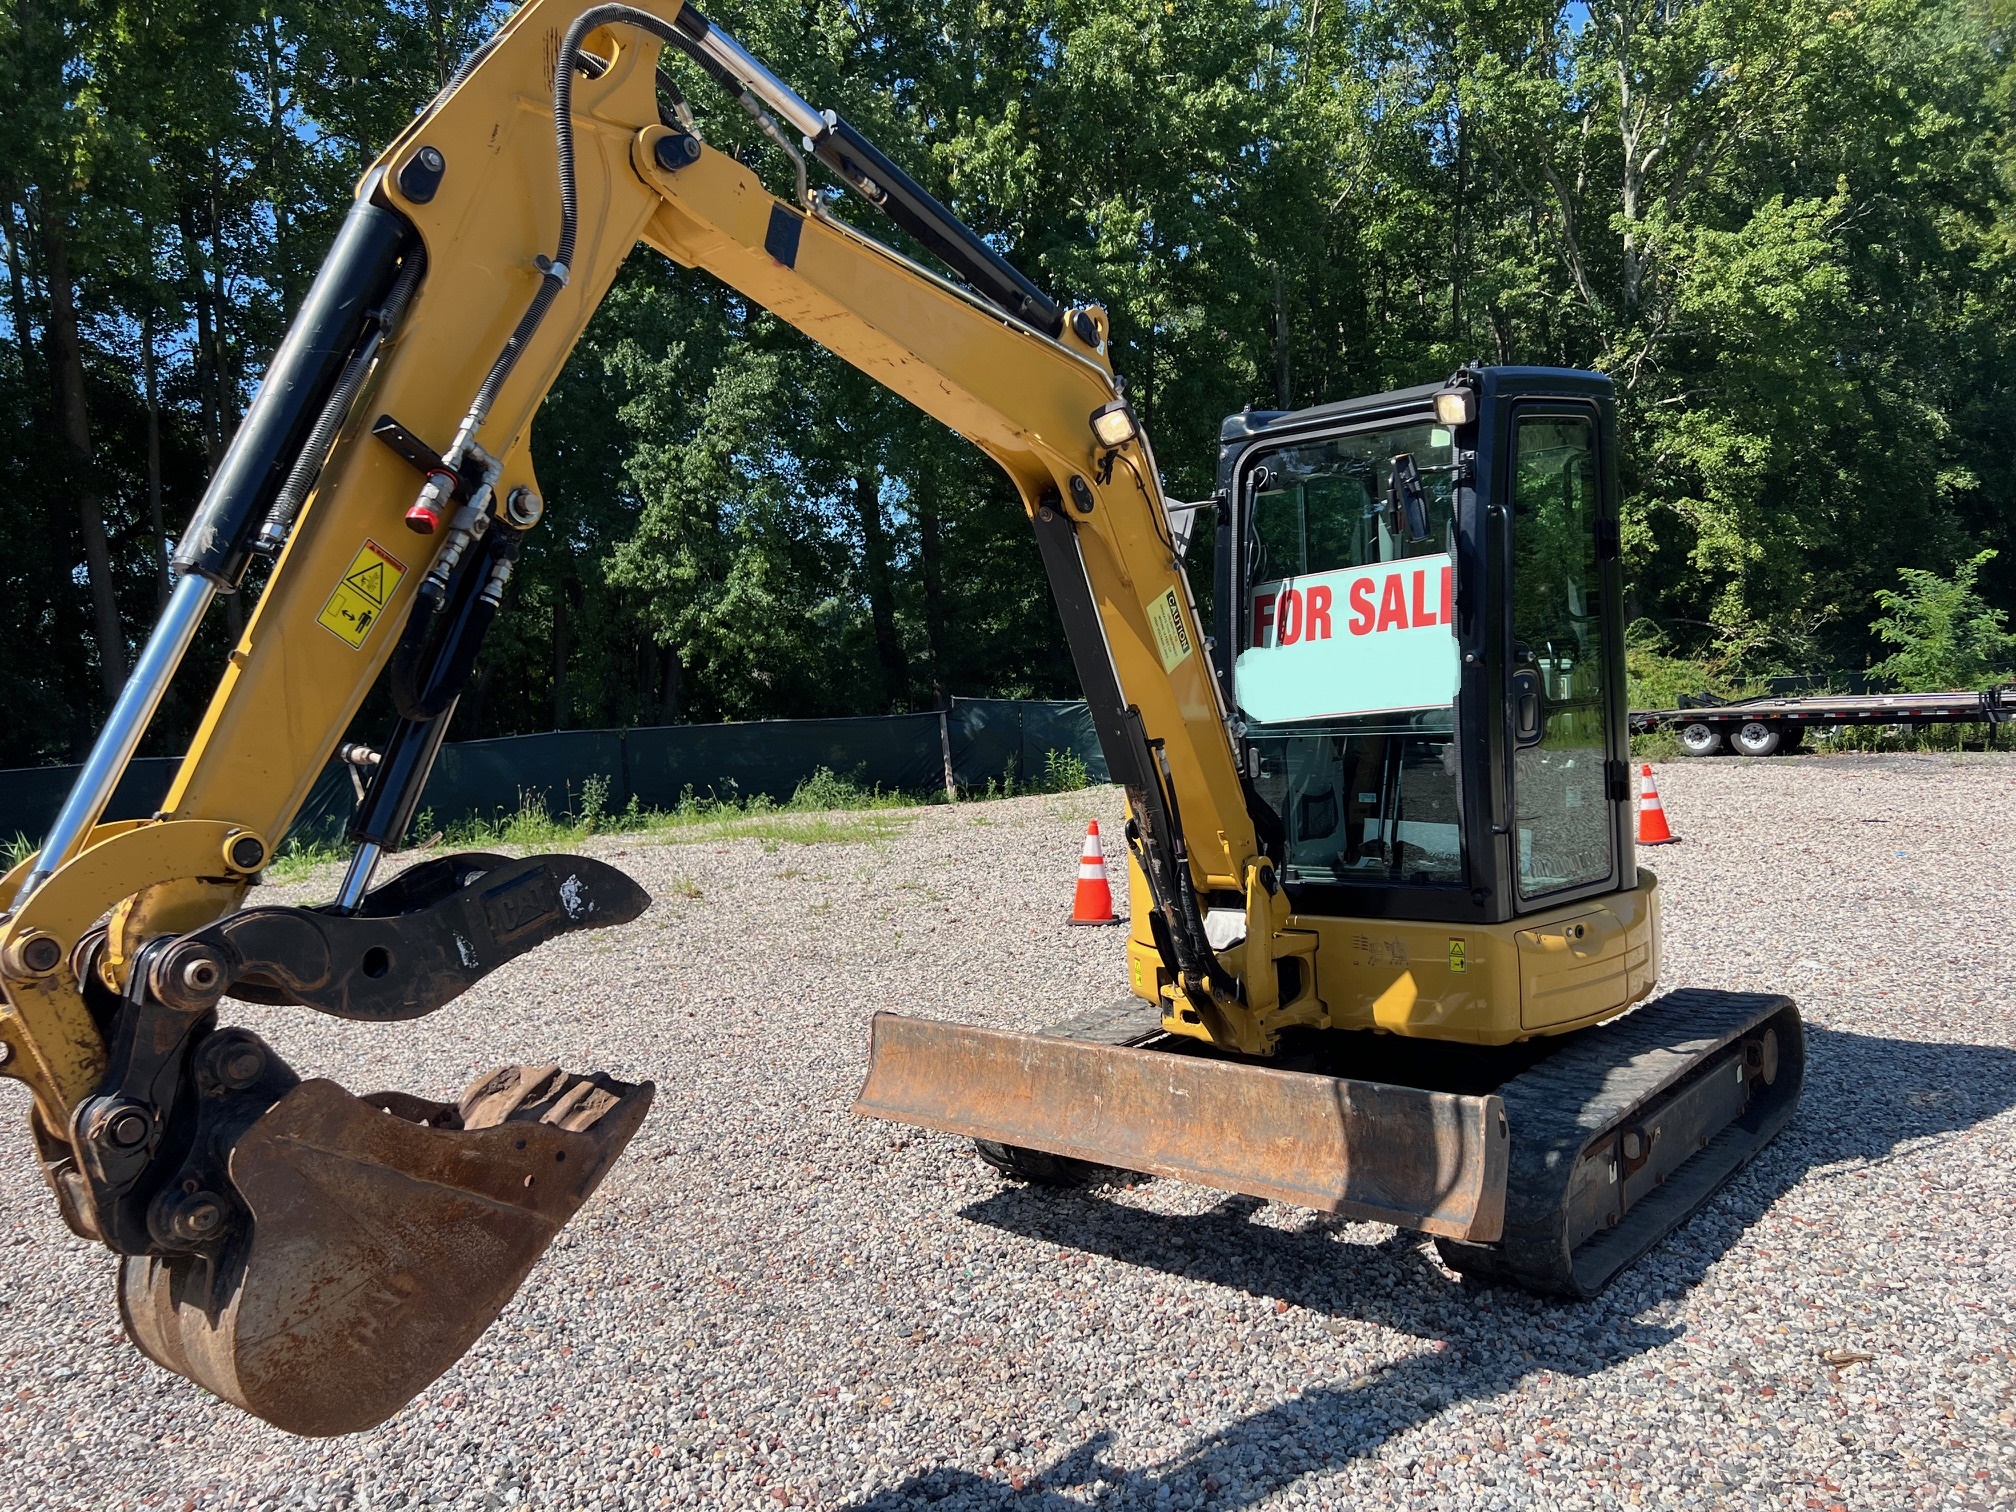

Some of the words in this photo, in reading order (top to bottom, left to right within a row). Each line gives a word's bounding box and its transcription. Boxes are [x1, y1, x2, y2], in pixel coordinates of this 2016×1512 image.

[1168, 596, 1188, 650] CAUTION
[1253, 585, 1333, 647] FOR
[498, 882, 549, 931] CAT
